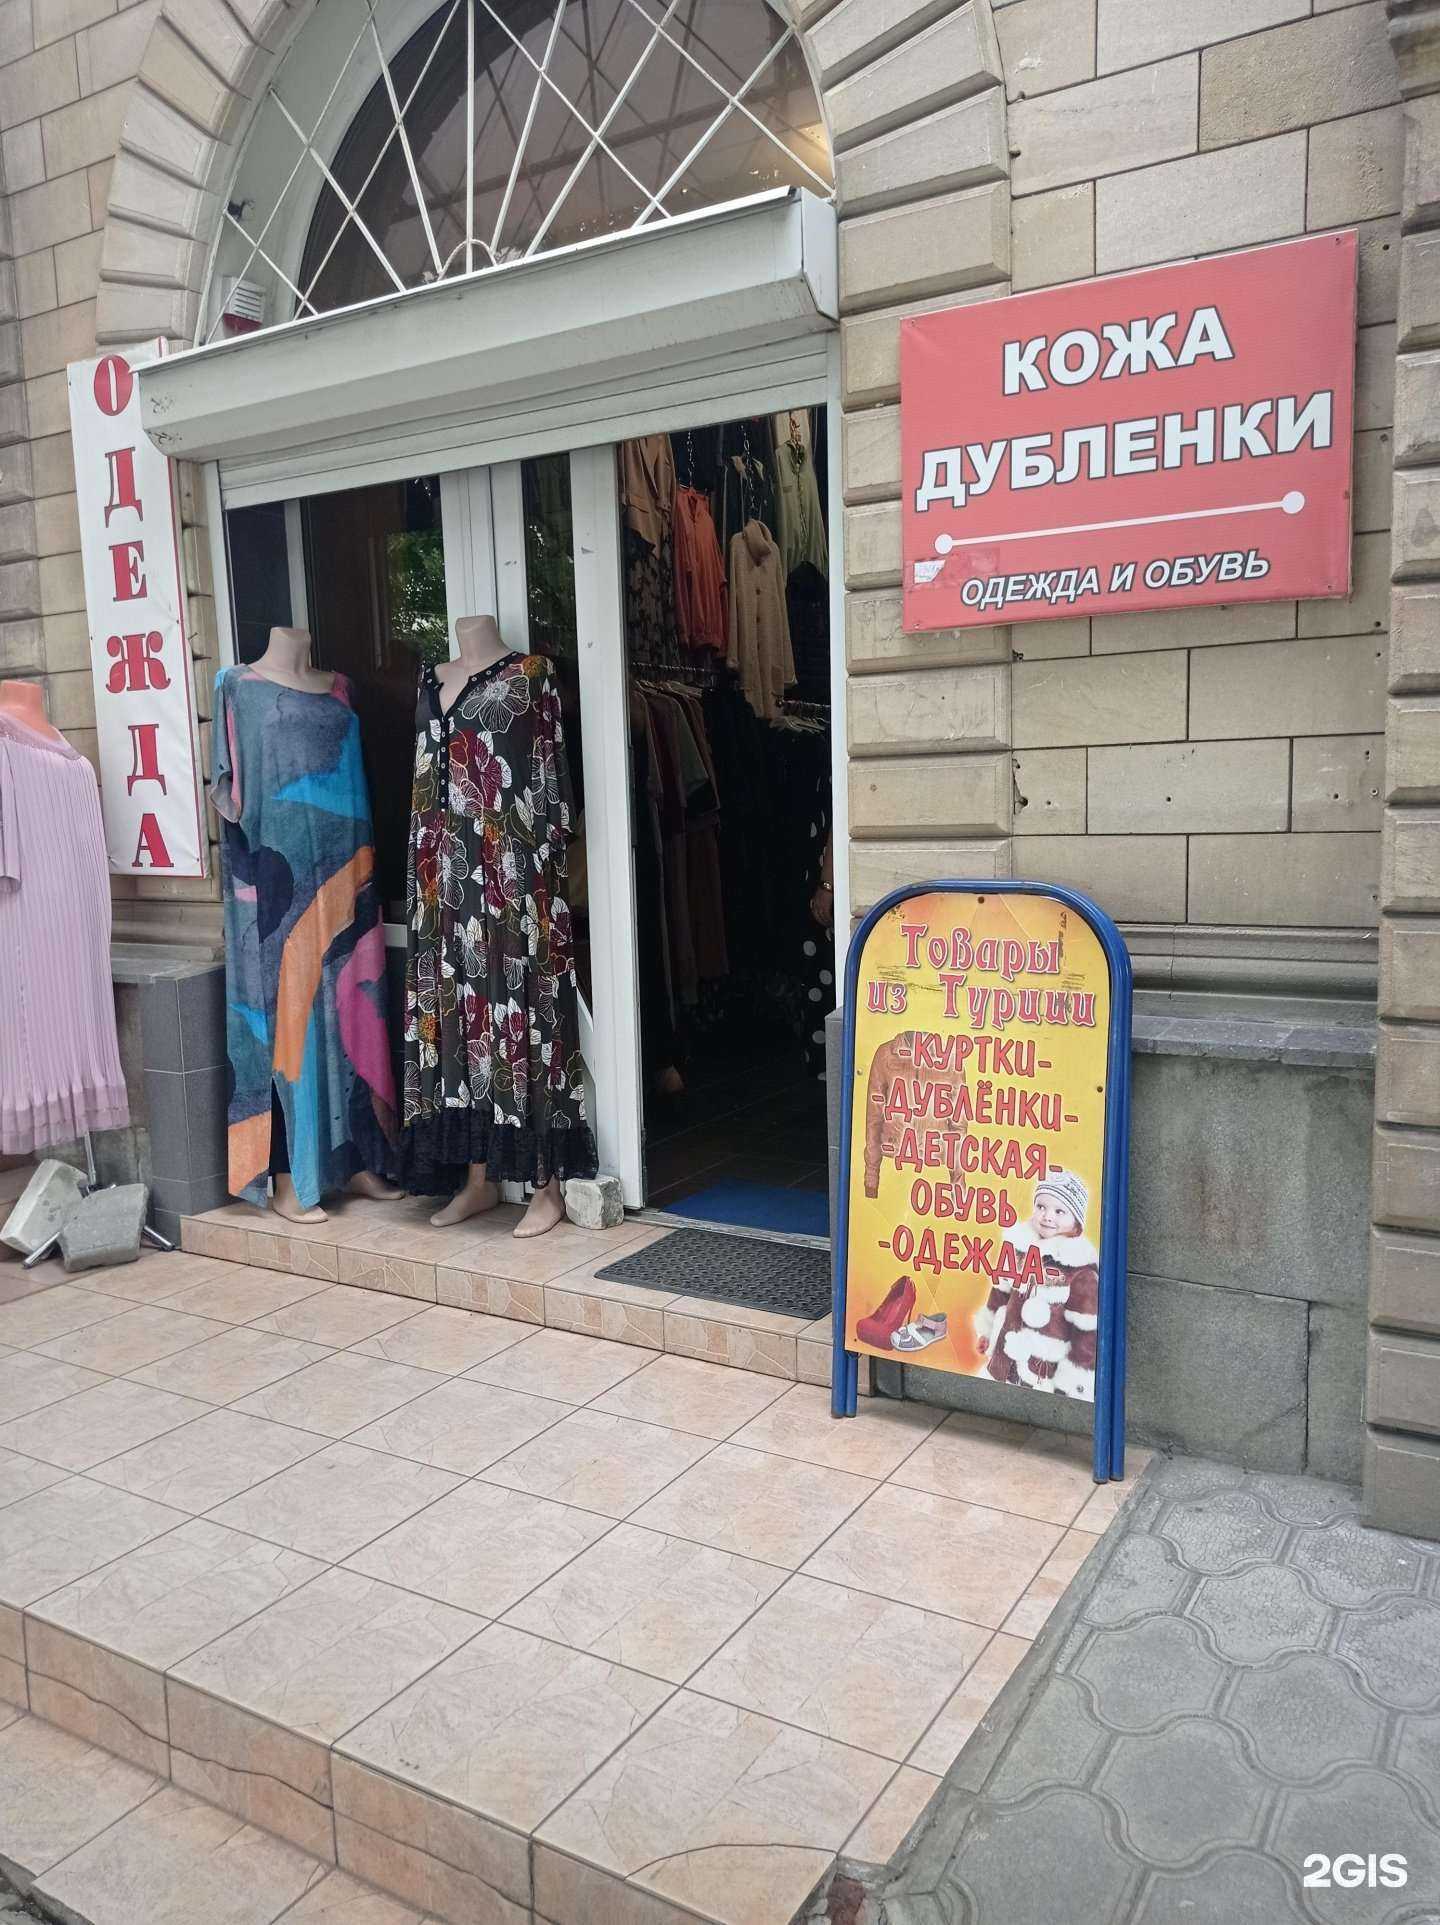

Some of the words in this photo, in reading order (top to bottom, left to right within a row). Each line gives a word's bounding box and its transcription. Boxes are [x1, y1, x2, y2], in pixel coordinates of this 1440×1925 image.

[1002, 305, 1235, 396] КОЖА
[914, 390, 1334, 512] ДУБЛЕНКИ
[961, 567, 1099, 612] ОДЕЖДА
[1109, 563, 1136, 593] И
[1144, 549, 1271, 588] ОБУВЬ
[93, 355, 174, 867] ОДЕЖДА
[900, 923, 1060, 982] Товары
[867, 980, 907, 1013] из
[938, 973, 1096, 1030] Турции
[899, 1032, 1052, 1078] -КУРТКИ-
[872, 1079, 1079, 1132] -ДУБЛЁНКИ-
[881, 1128, 1063, 1181] -ДЕТСКАЯ-
[911, 1178, 1018, 1228] ОБУВЬ
[878, 1225, 1060, 1287] -ОДЕЖДА-
